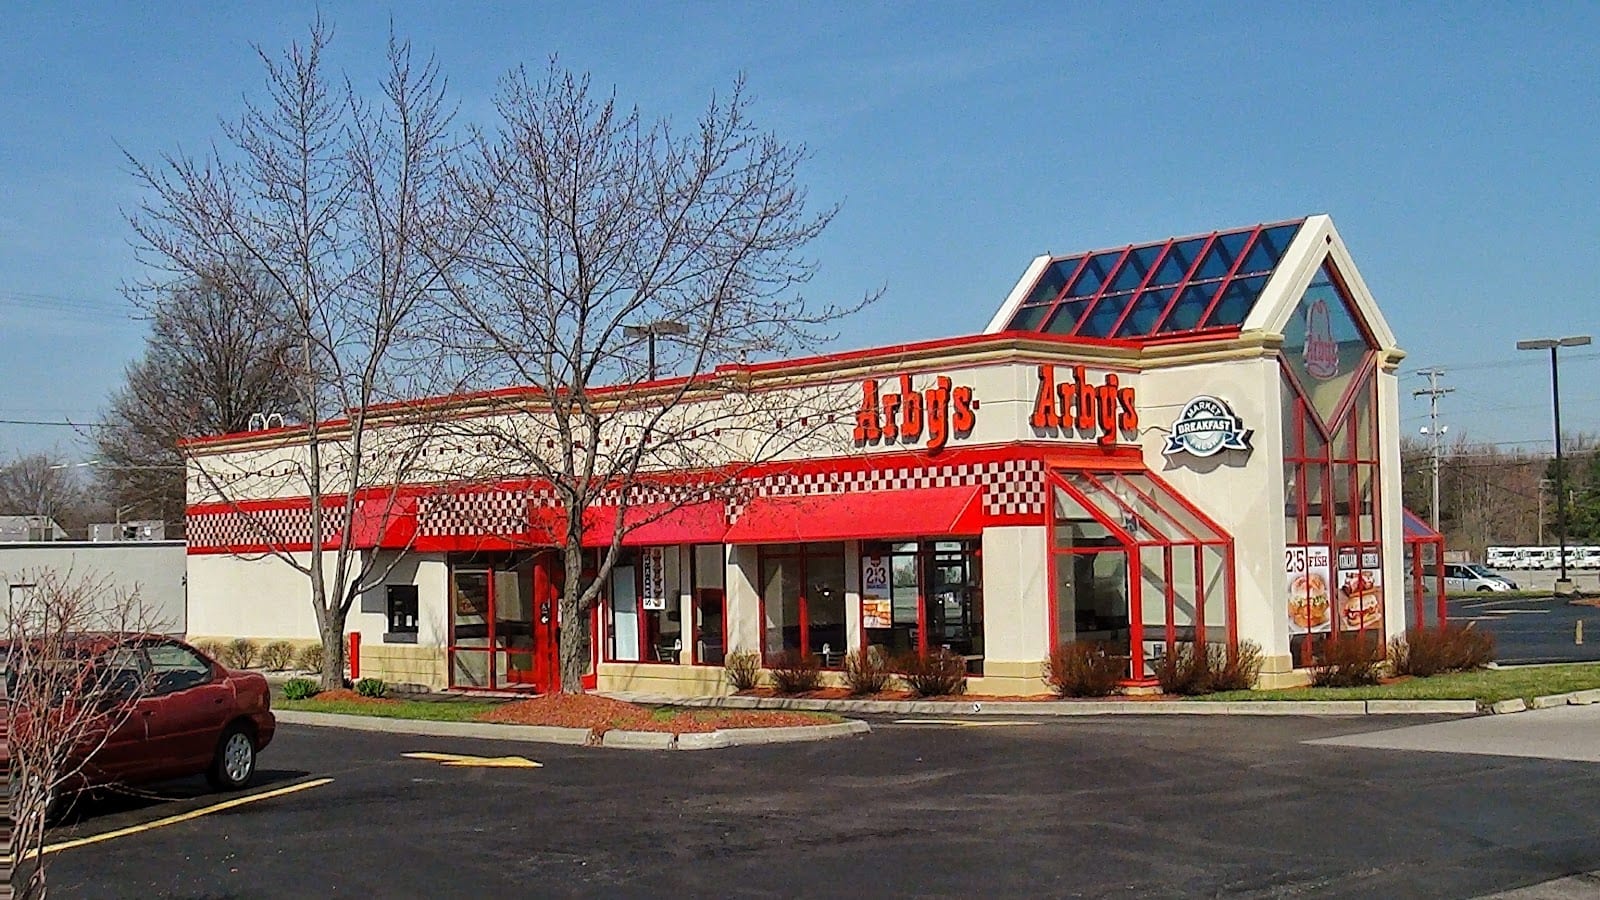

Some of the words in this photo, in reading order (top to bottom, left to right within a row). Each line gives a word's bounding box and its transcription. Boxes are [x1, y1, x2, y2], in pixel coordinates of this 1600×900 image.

[854, 373, 974, 450] Arby's
[1031, 364, 1137, 446] Arby's
[1187, 401, 1221, 418] MARKET
[1178, 421, 1231, 435] BREAKFAST
[1309, 556, 1327, 567] FISH
